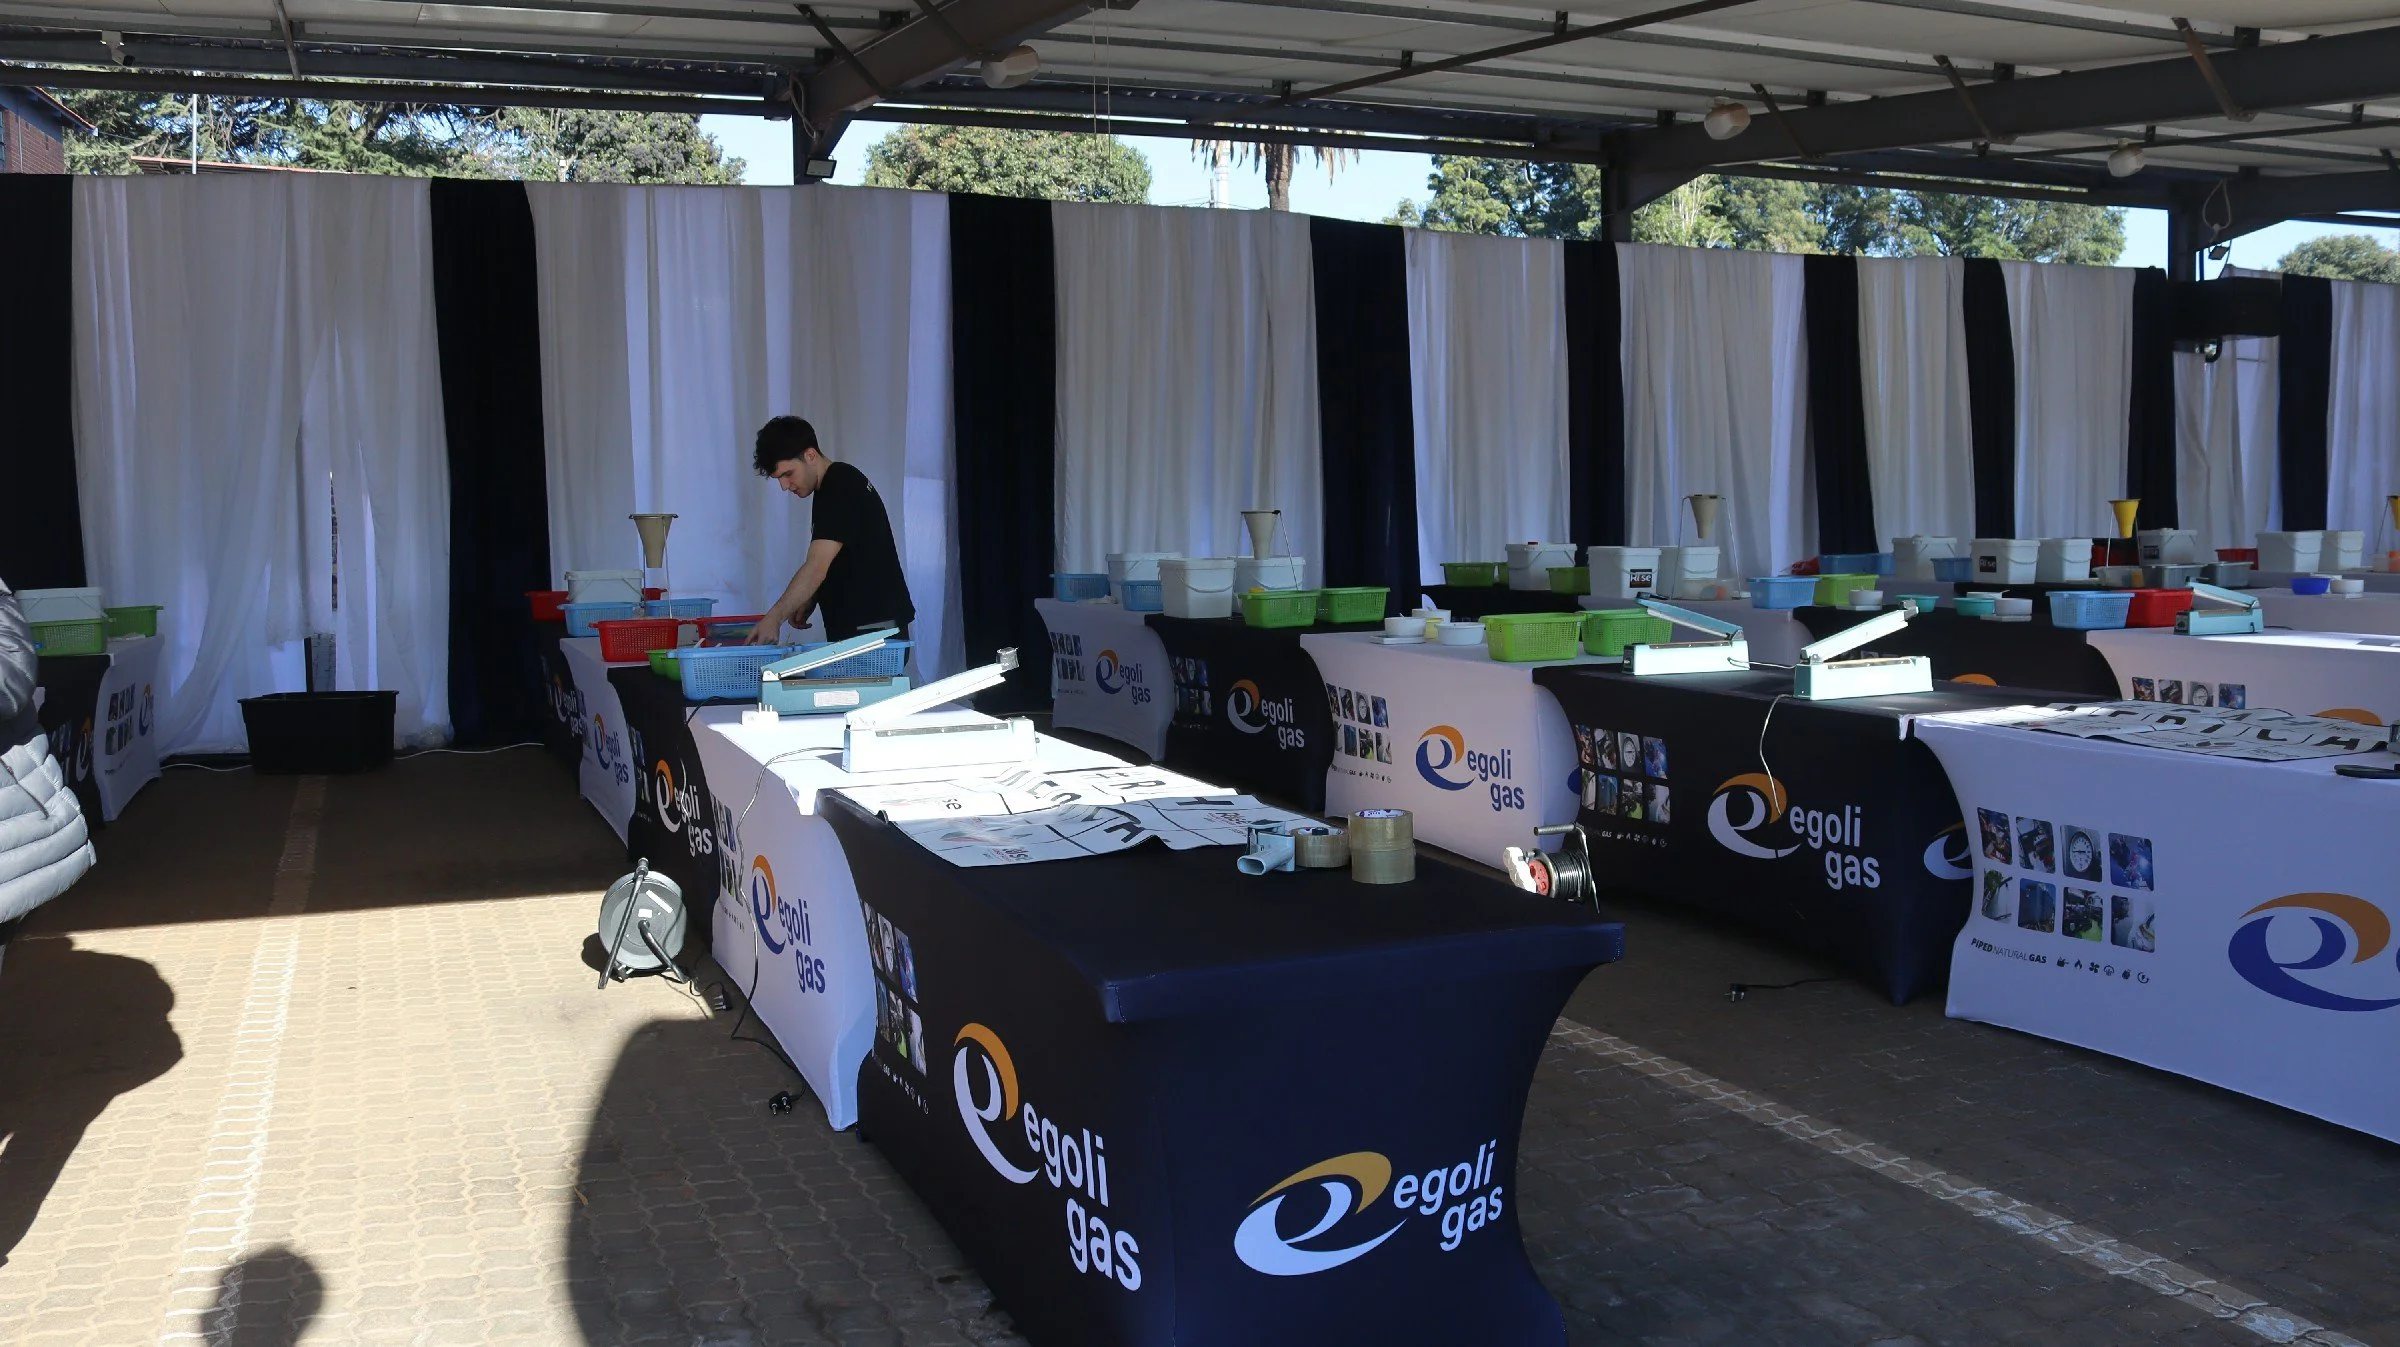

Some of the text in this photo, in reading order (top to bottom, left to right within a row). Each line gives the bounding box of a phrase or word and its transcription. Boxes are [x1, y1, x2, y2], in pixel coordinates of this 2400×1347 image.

[1119, 663, 1143, 686] egoli
[1131, 686, 1151, 705] gas
[1261, 698, 1294, 725] egoli
[1278, 726, 1305, 750] gas
[1467, 748, 1511, 782] egoli
[1490, 783, 1525, 812] gas
[687, 825, 713, 857] gas
[1789, 804, 1861, 850] egoli
[1825, 850, 1880, 890] gas
[777, 895, 811, 946] egoli
[795, 949, 825, 994] gas
[1023, 1102, 1109, 1208] egoli
[1393, 1138, 1497, 1216] egoli
[1440, 1186, 1503, 1252] gas
[1066, 1197, 1142, 1291] gas
